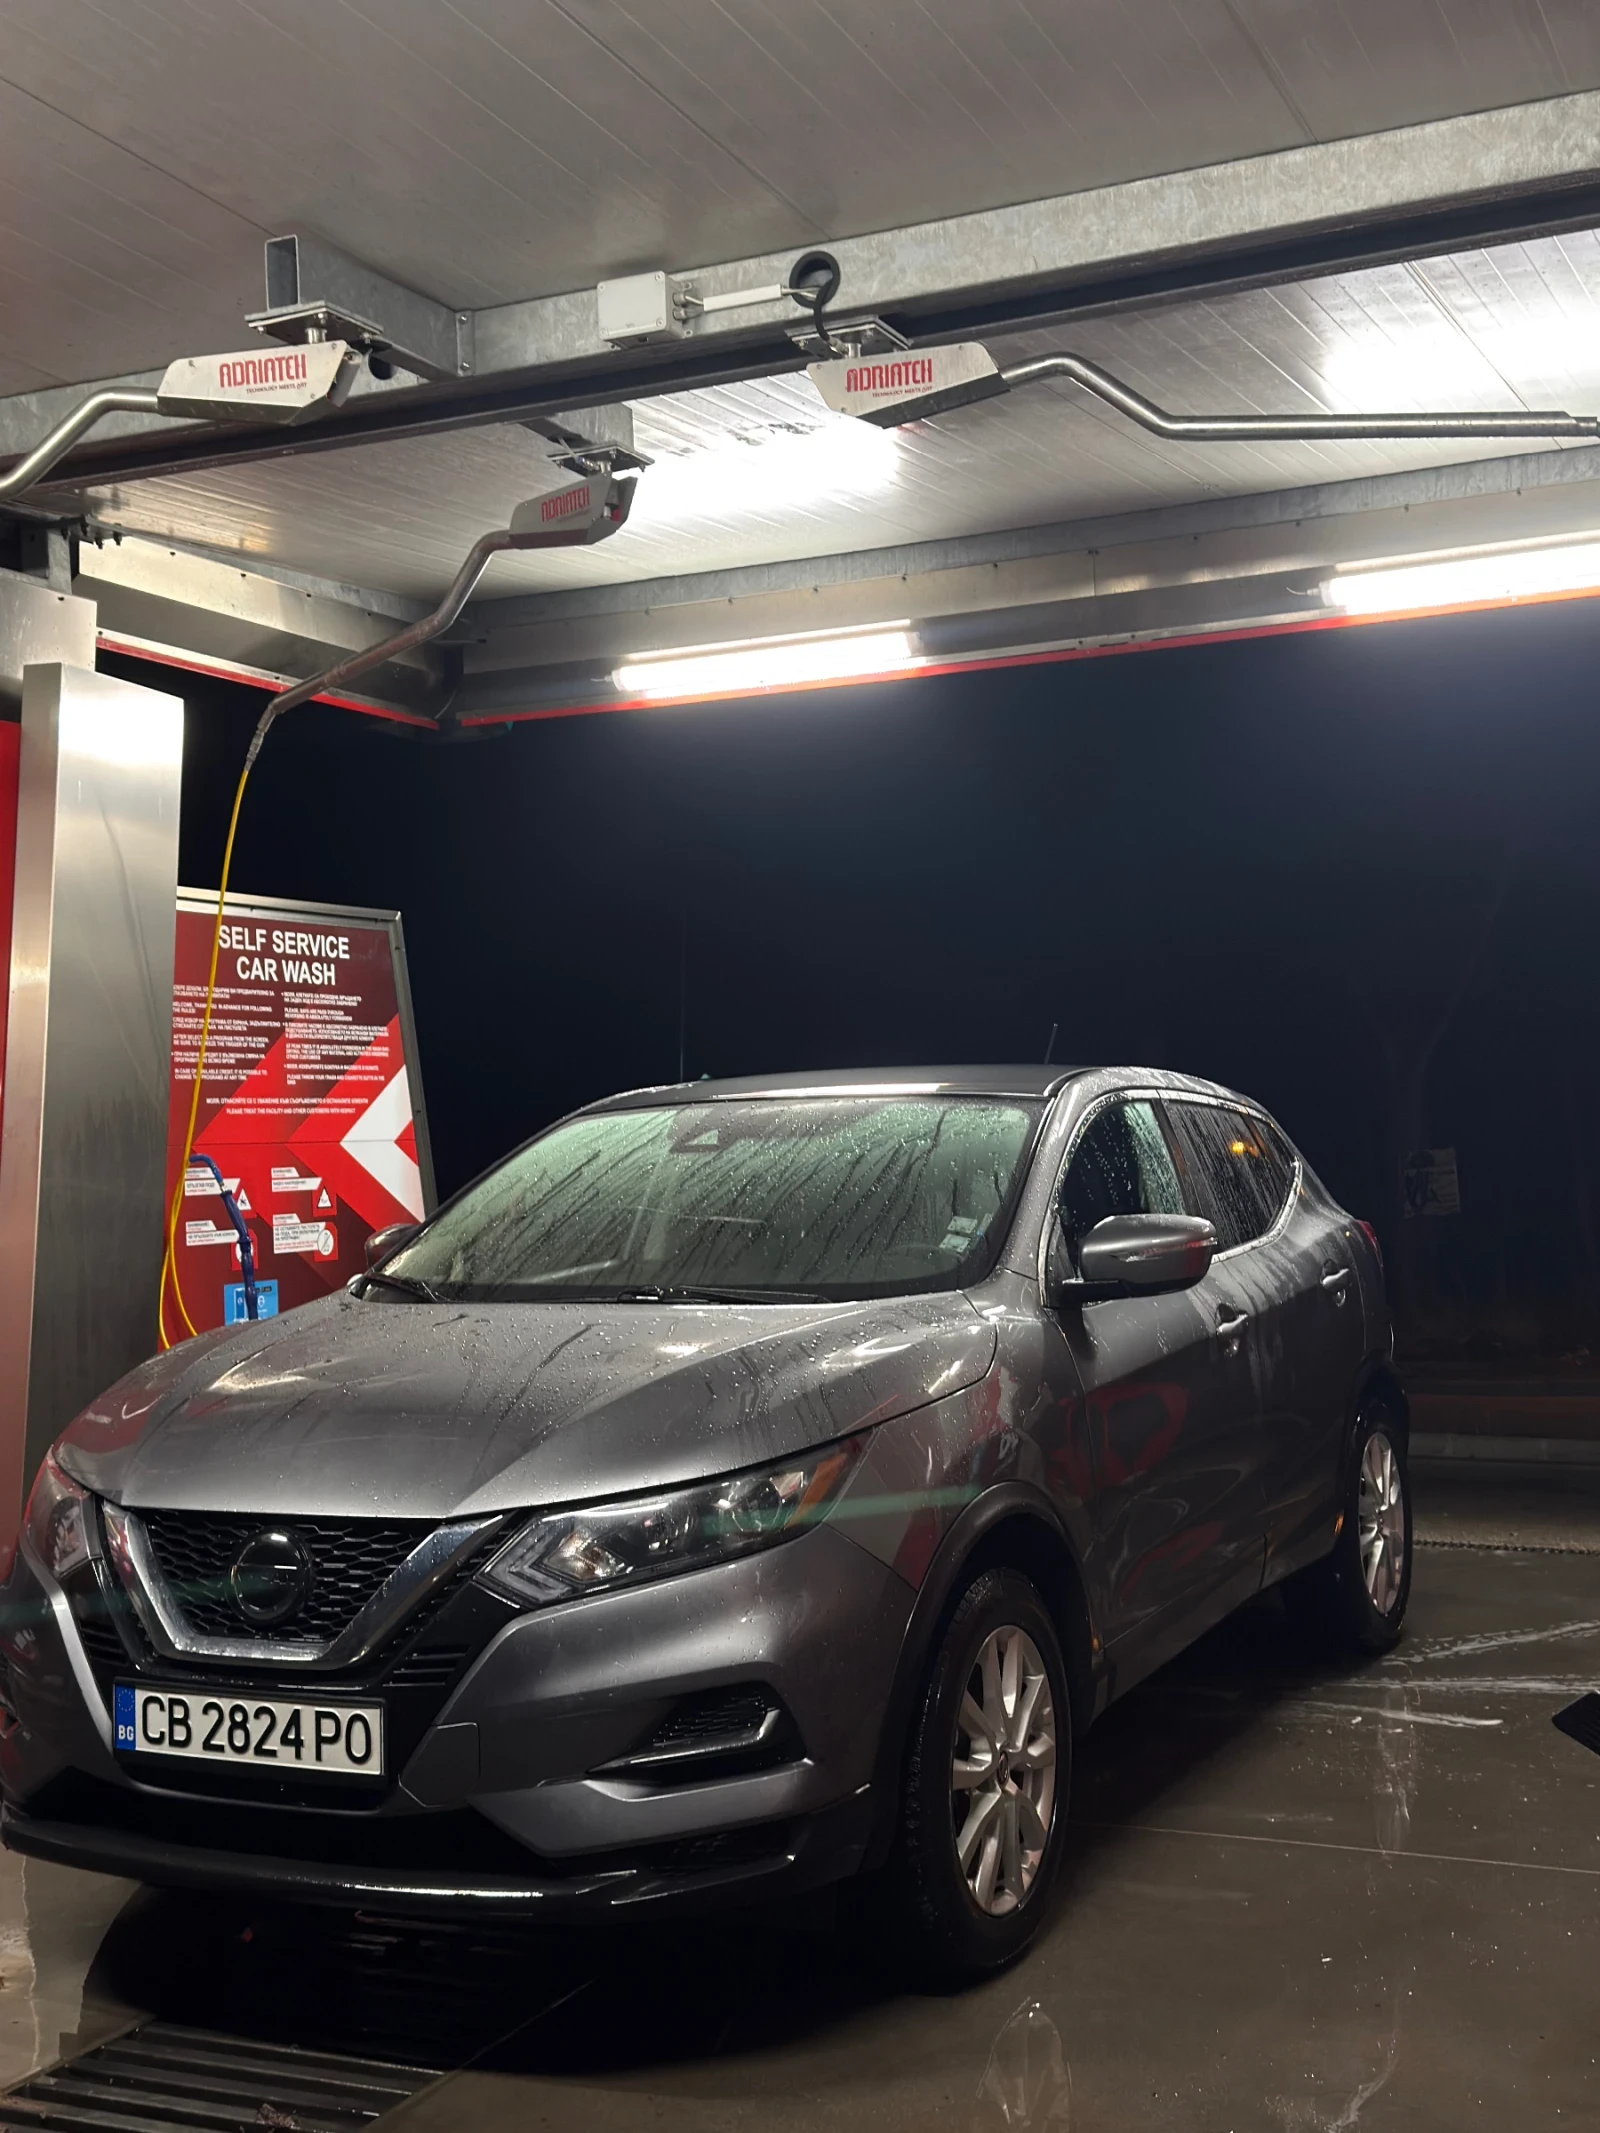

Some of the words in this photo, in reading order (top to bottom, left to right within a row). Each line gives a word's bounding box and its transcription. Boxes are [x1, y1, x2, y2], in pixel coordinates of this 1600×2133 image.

[219, 925, 267, 951] SELF
[272, 930, 350, 959] SERVICE
[236, 956, 278, 981] CAR
[281, 959, 336, 985] WASH
[118, 1725, 134, 1741] BG
[142, 1695, 192, 1748] CB
[202, 1701, 304, 1760] 2824
[315, 1710, 372, 1765] PO
